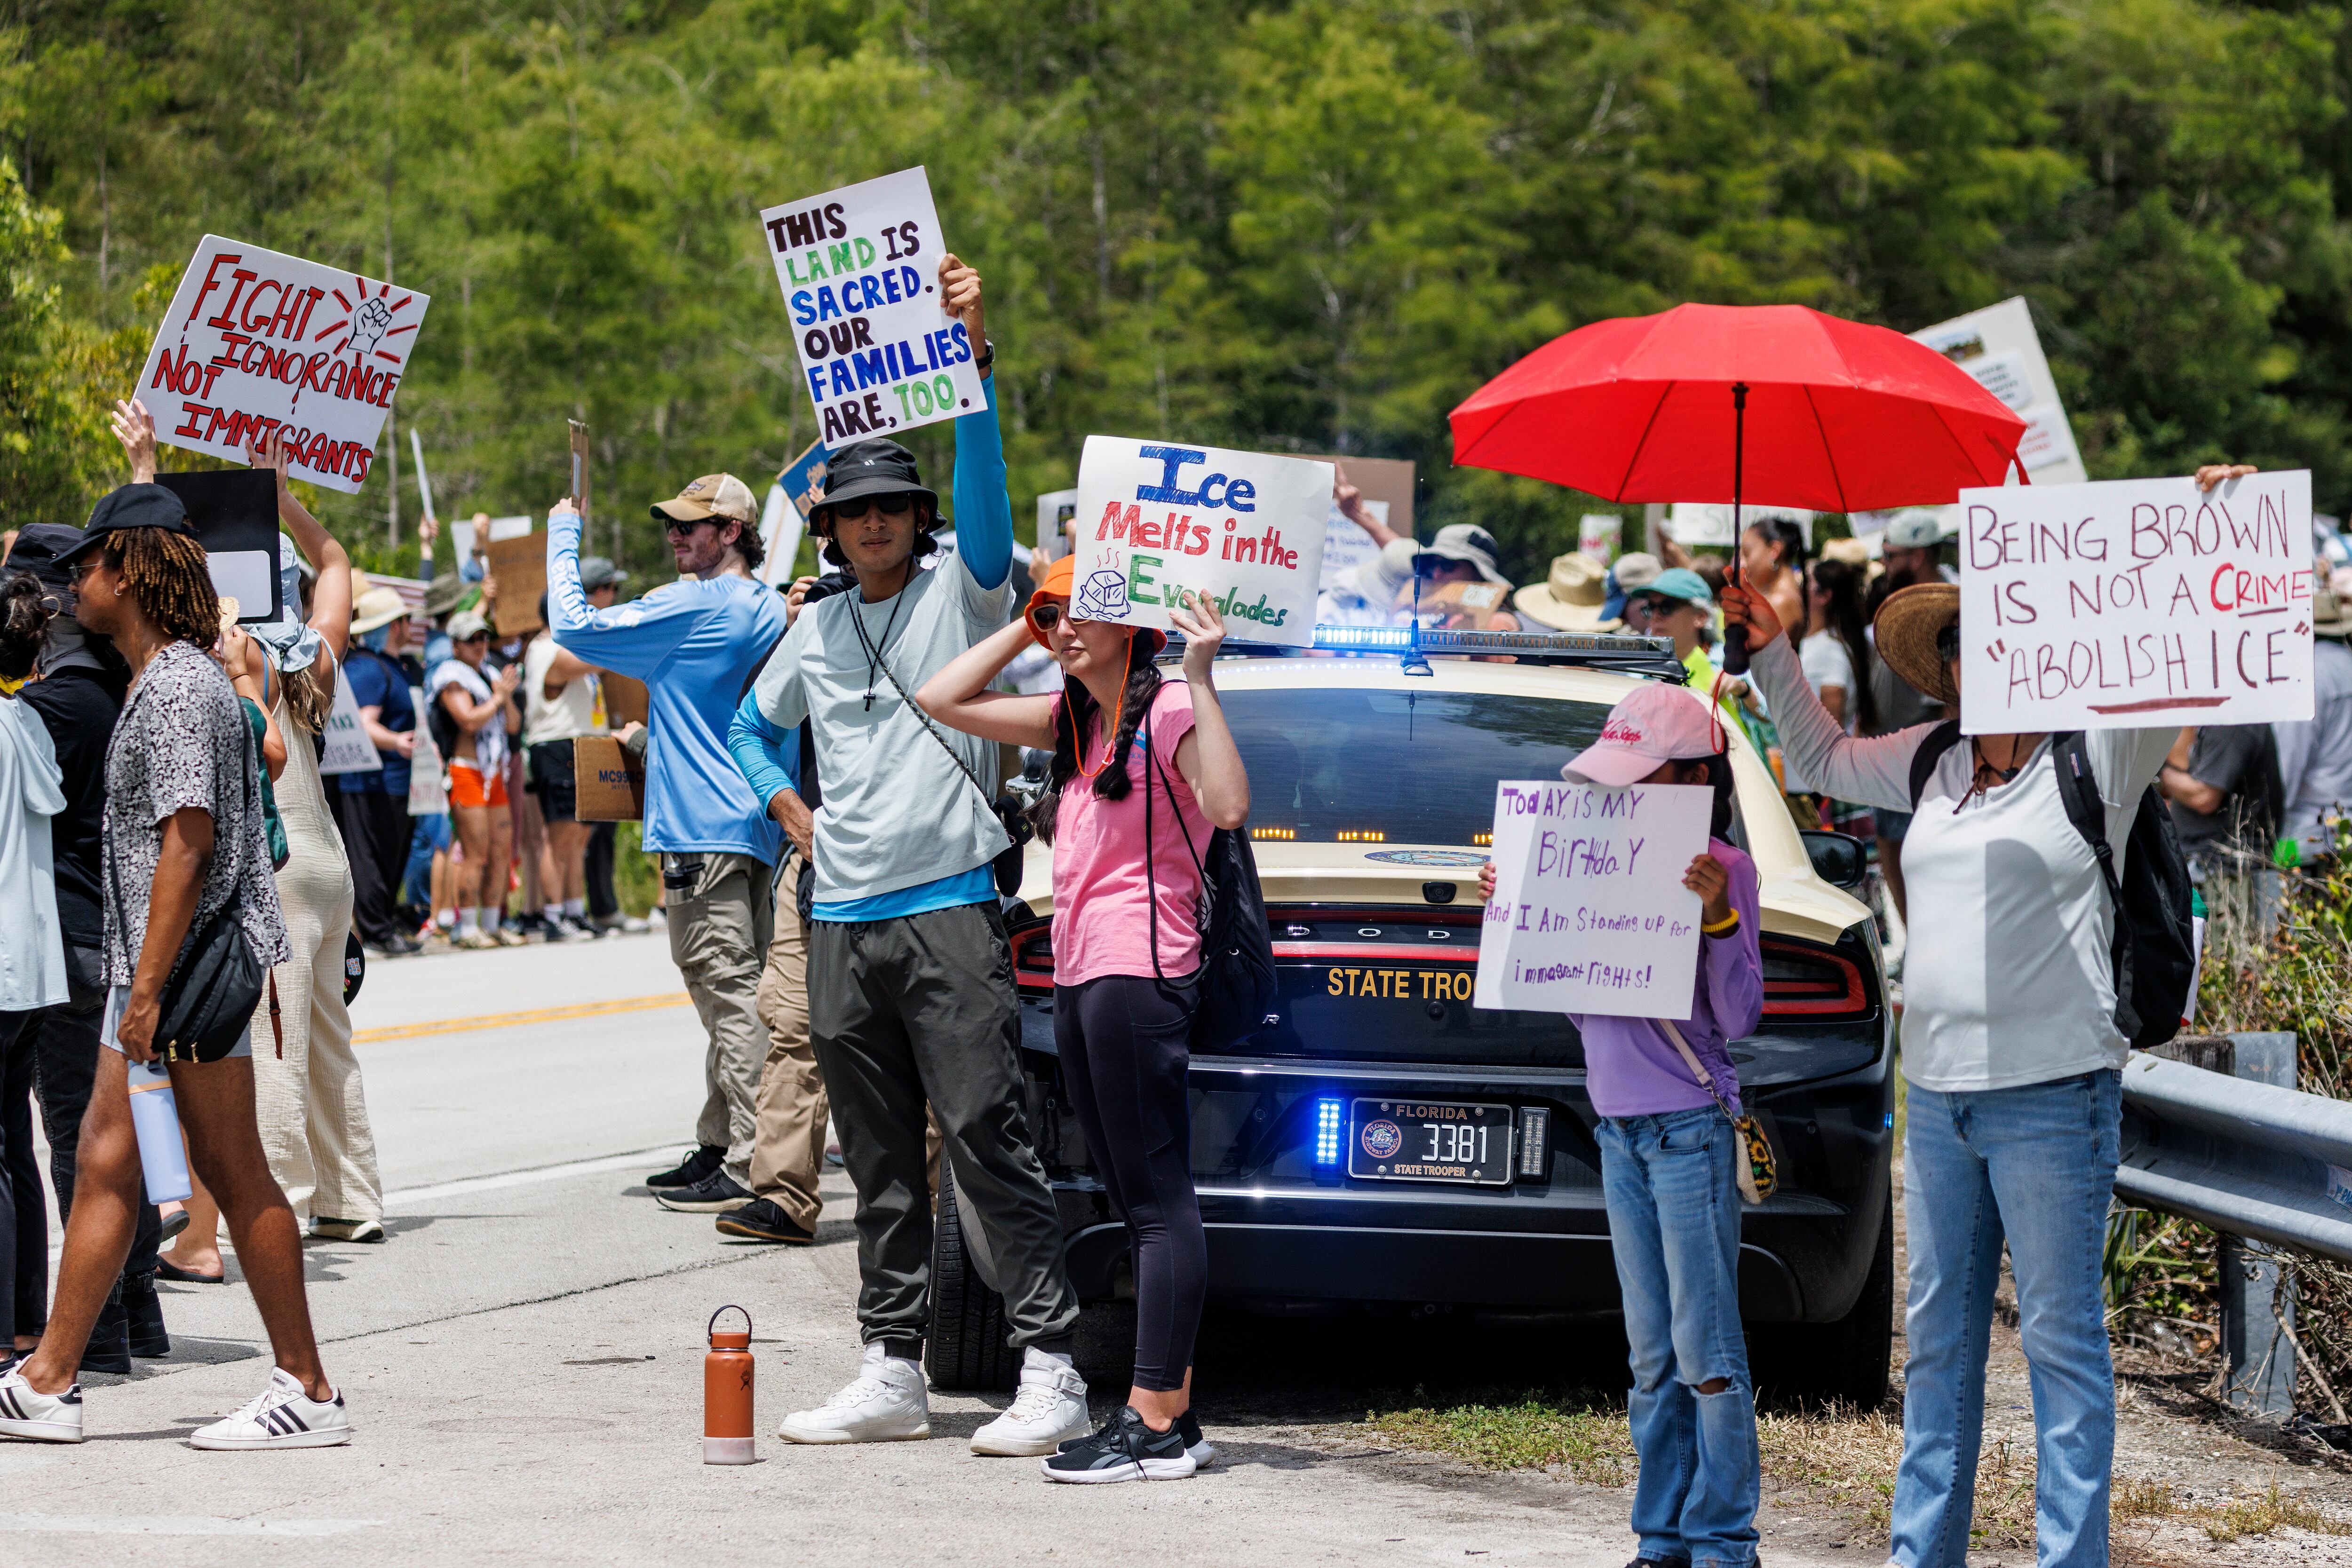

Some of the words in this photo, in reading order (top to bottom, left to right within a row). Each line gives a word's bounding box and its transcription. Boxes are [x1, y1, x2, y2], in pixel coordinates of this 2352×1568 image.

[767, 203, 847, 252] THIS
[786, 237, 876, 287] LAND
[882, 221, 921, 261] IS
[186, 253, 325, 341] FIGHT
[791, 266, 934, 326] SACRED.
[804, 317, 875, 360] OUR
[808, 323, 972, 403] FAMILIES
[151, 344, 224, 399] NOT
[211, 332, 401, 408] IGNORANCE
[823, 392, 898, 443] ARE,
[893, 374, 970, 421] TOO.
[175, 401, 373, 483] IMMIGRANTS
[1136, 445, 1256, 512] Ice
[1095, 501, 1211, 556] Melts
[1222, 518, 1257, 562] in
[1260, 525, 1298, 570] the
[1969, 505, 2108, 570] BEING
[2131, 490, 2289, 560] BROWN
[1994, 580, 2037, 626] IS
[2069, 561, 2155, 618] NOT
[2169, 573, 2200, 616] A
[1986, 633, 2190, 710] "ABOLISH
[1601, 790, 1645, 820] MY
[1485, 901, 1511, 923] And
[1516, 904, 1532, 931] I
[1539, 907, 1569, 932] Am
[1577, 906, 1638, 932] Standing
[1670, 921, 1692, 937] for
[1327, 967, 1410, 998] STATE
[1419, 972, 1478, 1001] TRO
[1367, 1123, 1396, 1135] FLORIDA
[1372, 1132, 1391, 1142] 85
[1396, 1105, 1468, 1120] FLORIDA
[1394, 1164, 1423, 1175] STATE
[1424, 1165, 1466, 1177] TROOPER
[1422, 1123, 1488, 1164] 3381
[1124, 1408, 1138, 1421] Reebok
